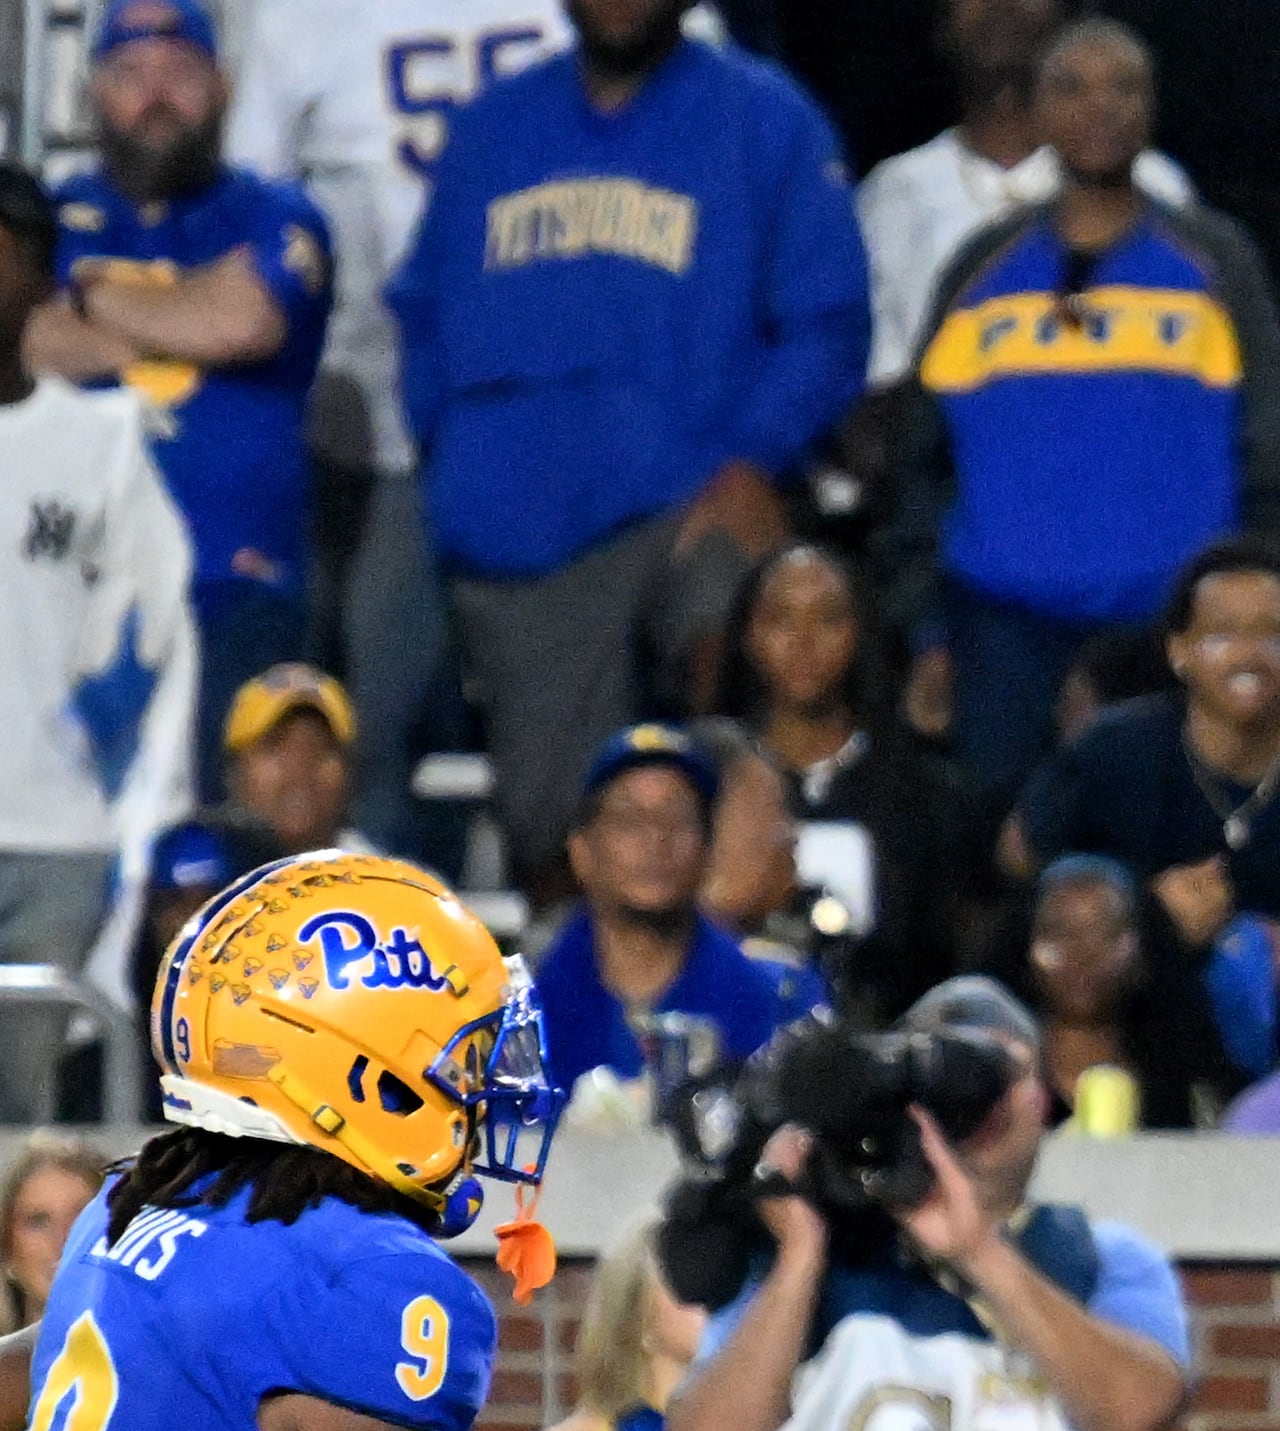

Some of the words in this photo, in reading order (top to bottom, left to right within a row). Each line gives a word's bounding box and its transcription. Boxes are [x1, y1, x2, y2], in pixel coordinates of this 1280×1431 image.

[297, 909, 446, 991] Pitt
[176, 1016, 191, 1063] 9
[395, 1294, 449, 1402] 9
